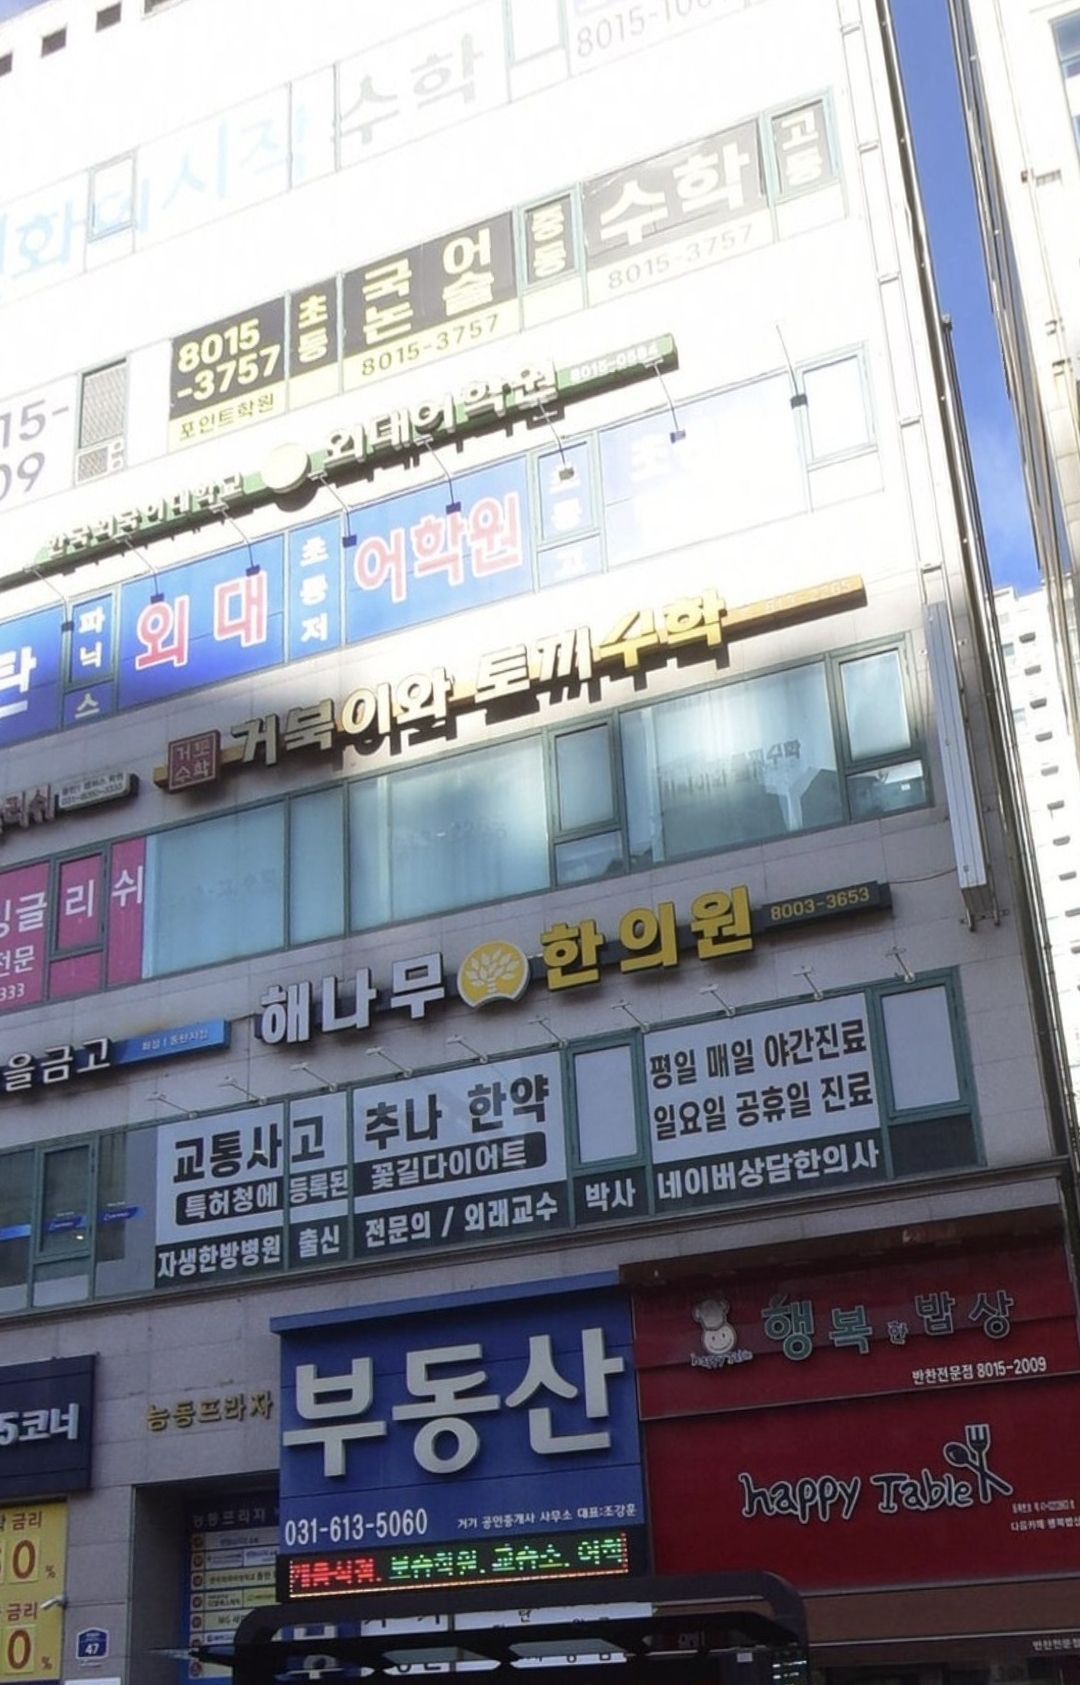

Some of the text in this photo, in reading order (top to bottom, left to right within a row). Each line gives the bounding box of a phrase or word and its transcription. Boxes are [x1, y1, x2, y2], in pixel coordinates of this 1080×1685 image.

[599, 141, 752, 246] 수학
[608, 223, 754, 290] 8015-3757
[177, 317, 261, 374] 8015
[298, 294, 329, 364] 초등
[361, 313, 499, 378] 8015-3757
[176, 344, 281, 402] -3757
[181, 392, 275, 440] 포인트학원
[353, 490, 524, 604] 어학원
[299, 535, 329, 643] 초등저
[74, 605, 107, 720] 파닉스
[229, 666, 456, 766] 거북이와
[260, 883, 870, 1044] 해나무 한의원 8003-3653
[3, 1037, 112, 1092] 을금고
[649, 1018, 868, 1091] 평일 매일 야간진료
[365, 1073, 550, 1151] 추나 한약
[653, 1070, 874, 1141] 일요일 공휴일 진료
[172, 1115, 326, 1184] 교통사고
[184, 1139, 527, 1220] 특허청에 등록된 꽃길다이어트
[157, 1233, 281, 1279] 자생한방병원
[297, 1224, 340, 1259] 출신
[365, 1209, 432, 1249] 전문의
[464, 1191, 558, 1233] 외래교수
[584, 1177, 637, 1212] 박사
[657, 1138, 880, 1200] 네이버상담한의사
[282, 1327, 626, 1478] 부동산
[911, 1356, 1048, 1387] 반찬전문점 8015-2009
[146, 1391, 275, 1433] 능동프라자
[12, 1511, 43, 1530] 금리
[284, 1507, 429, 1547] 031-613-5060
[481, 1510, 536, 1530] 공인중개사
[539, 1508, 574, 1524] 사무소
[738, 1467, 974, 1525] happy Table
[6, 1601, 38, 1622] 금리
[84, 1642, 101, 1656] 47
